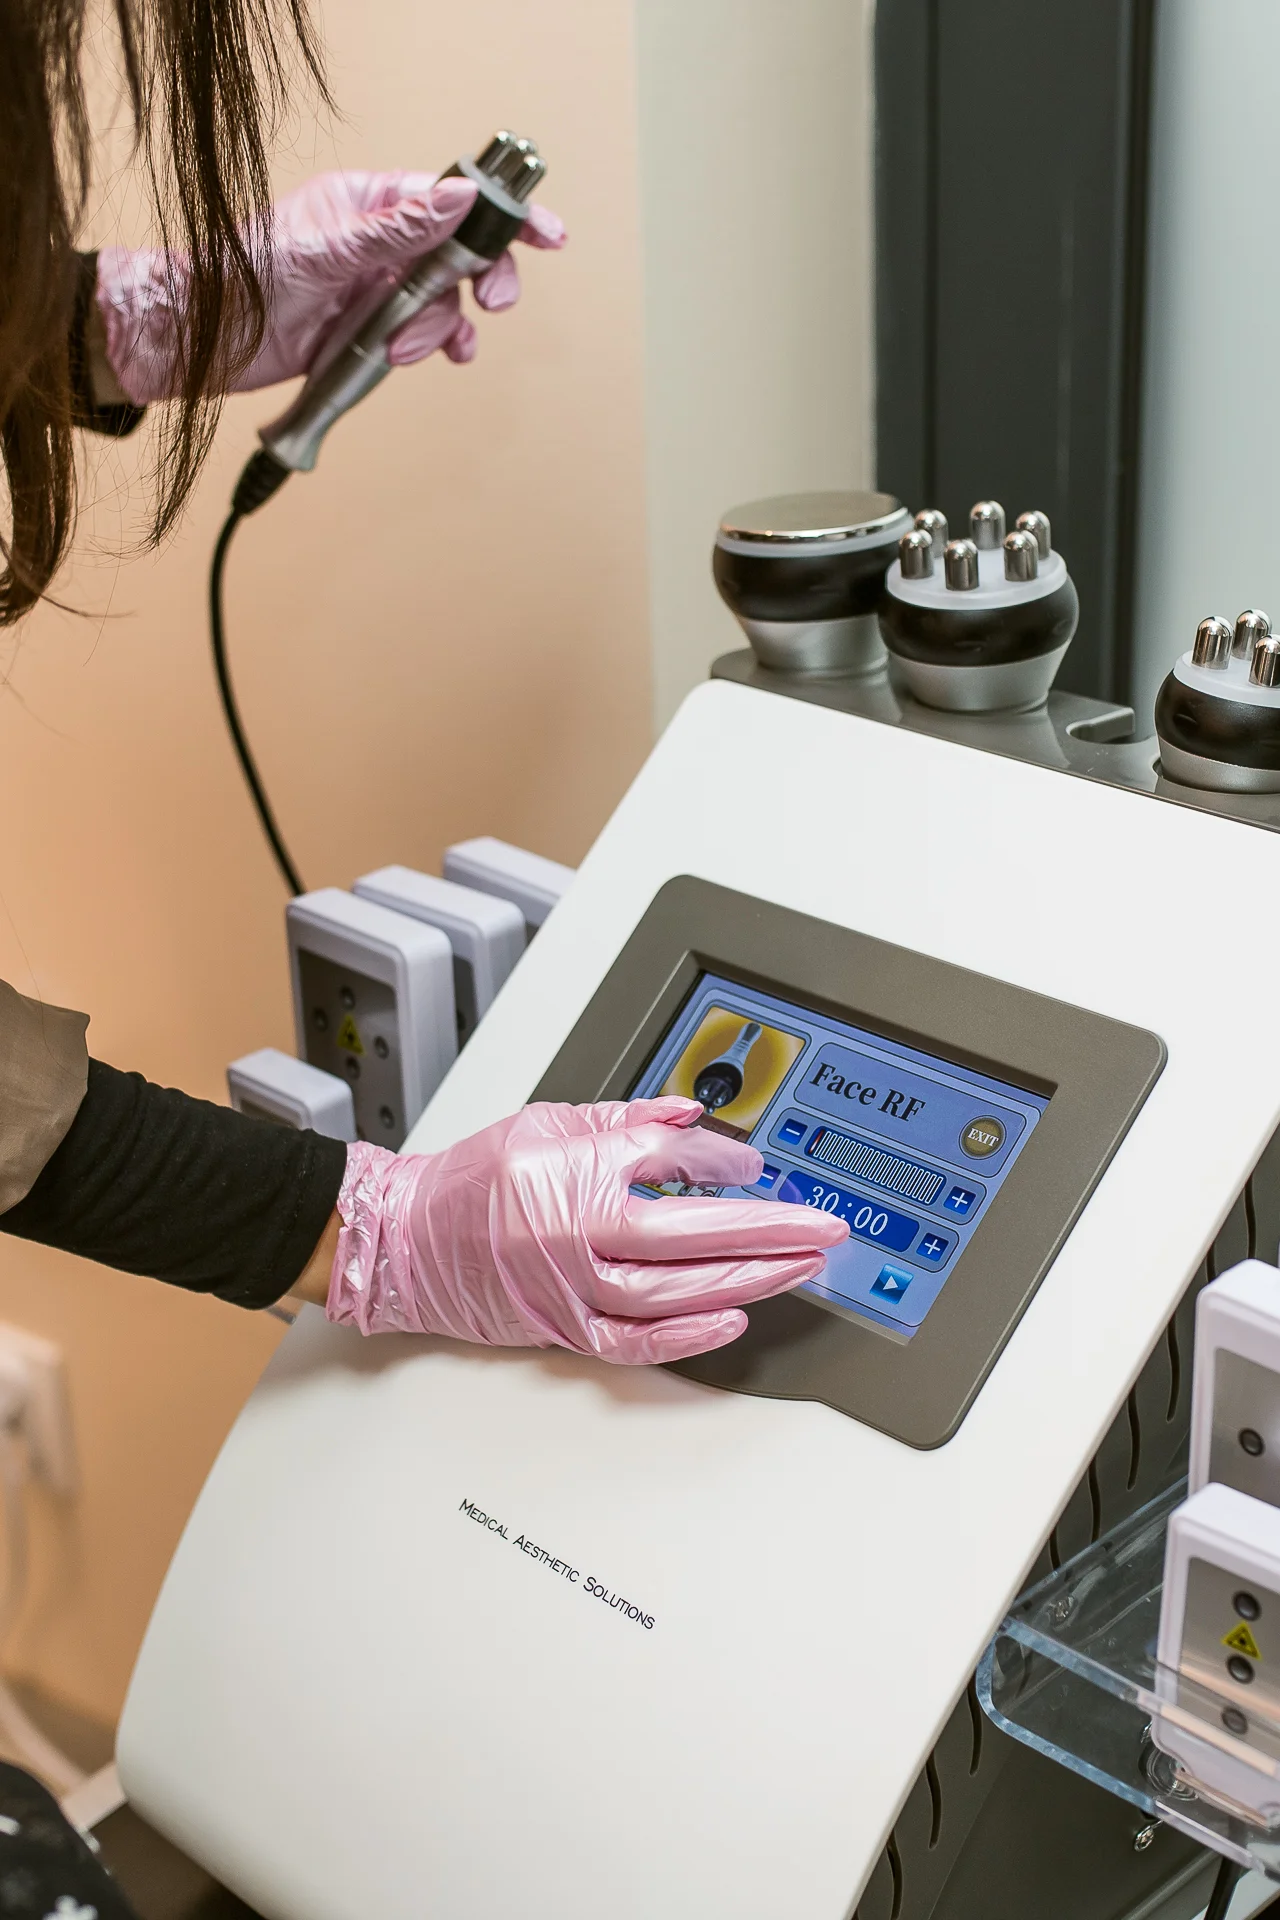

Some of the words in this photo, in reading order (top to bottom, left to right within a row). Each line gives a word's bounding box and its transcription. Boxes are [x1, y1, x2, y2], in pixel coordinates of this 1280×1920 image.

[809, 1062, 876, 1106] Face
[877, 1088, 926, 1122] RF
[967, 1127, 999, 1148] EXIT
[458, 1498, 508, 1540] MEDICAL
[512, 1534, 580, 1583] AESTHETIC
[583, 1576, 656, 1630] SOLUTIONS
